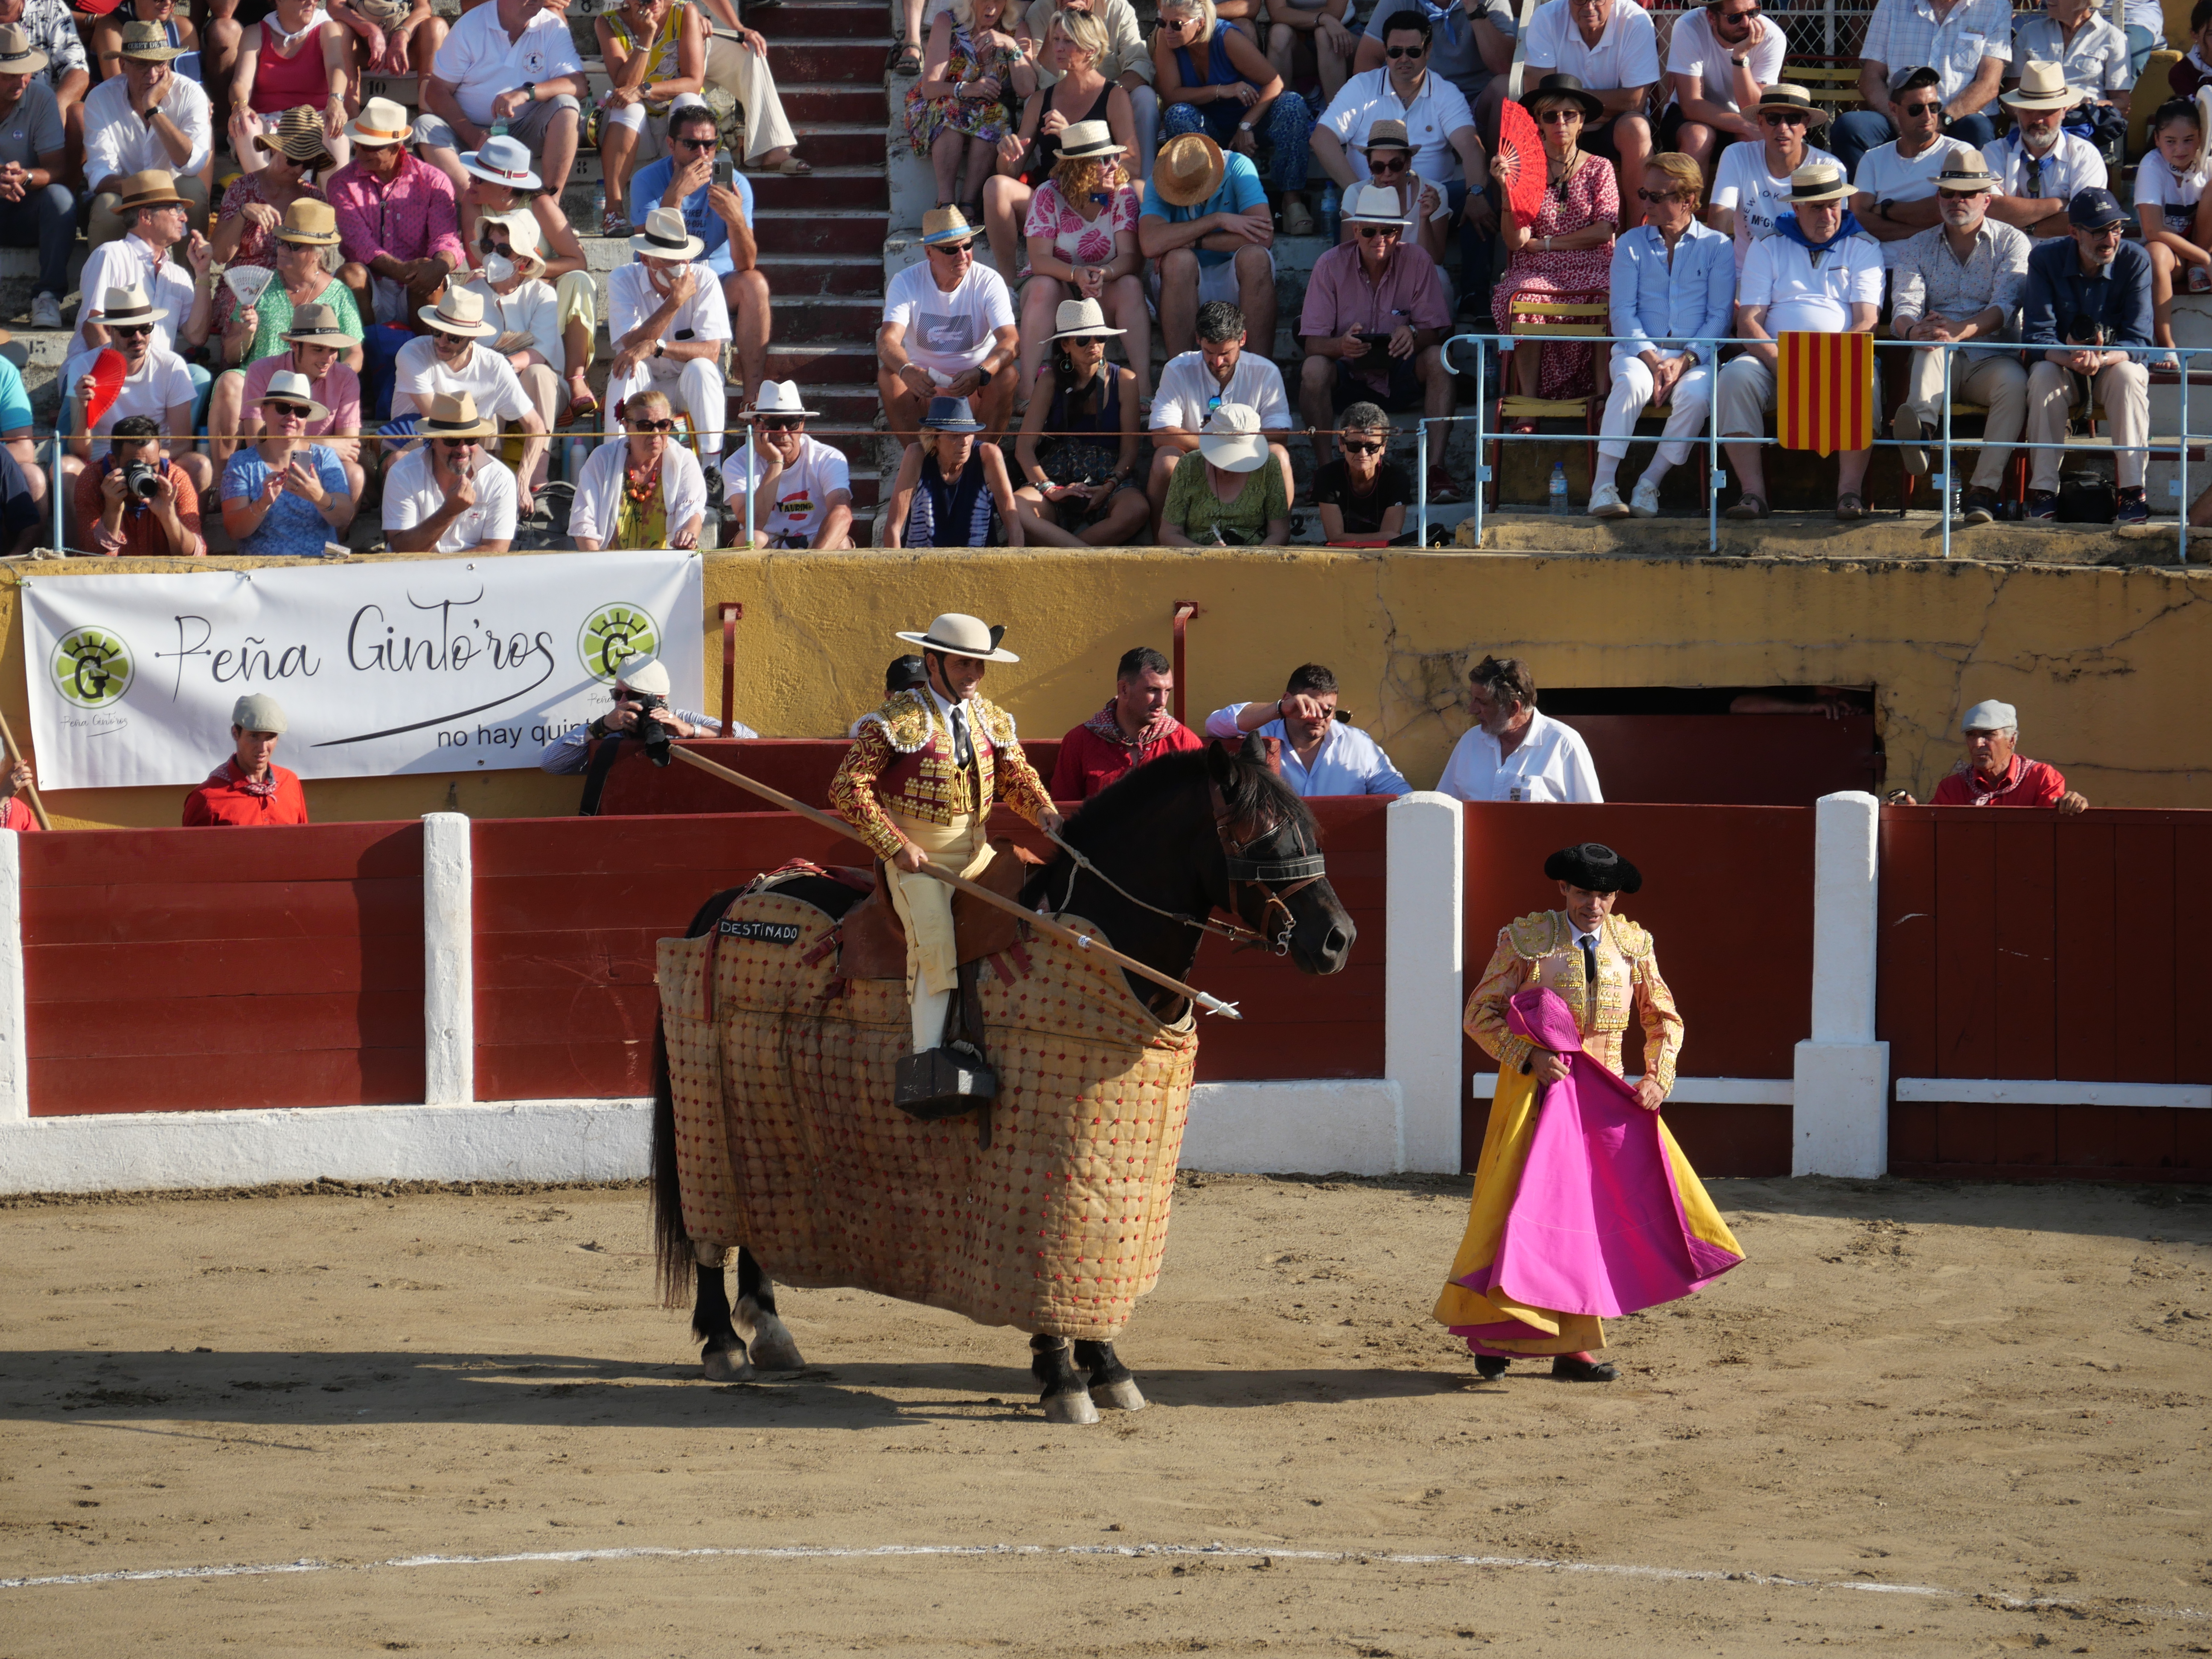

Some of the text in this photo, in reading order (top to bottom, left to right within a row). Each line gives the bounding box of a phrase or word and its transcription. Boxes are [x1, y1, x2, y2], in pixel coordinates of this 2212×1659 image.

[367, 81, 387, 95] 10
[576, 161, 588, 175] 8
[29, 341, 46, 354] 15
[154, 615, 320, 703] Peña
[61, 716, 89, 730] Peña
[438, 731, 468, 747] no
[478, 724, 523, 749] hay
